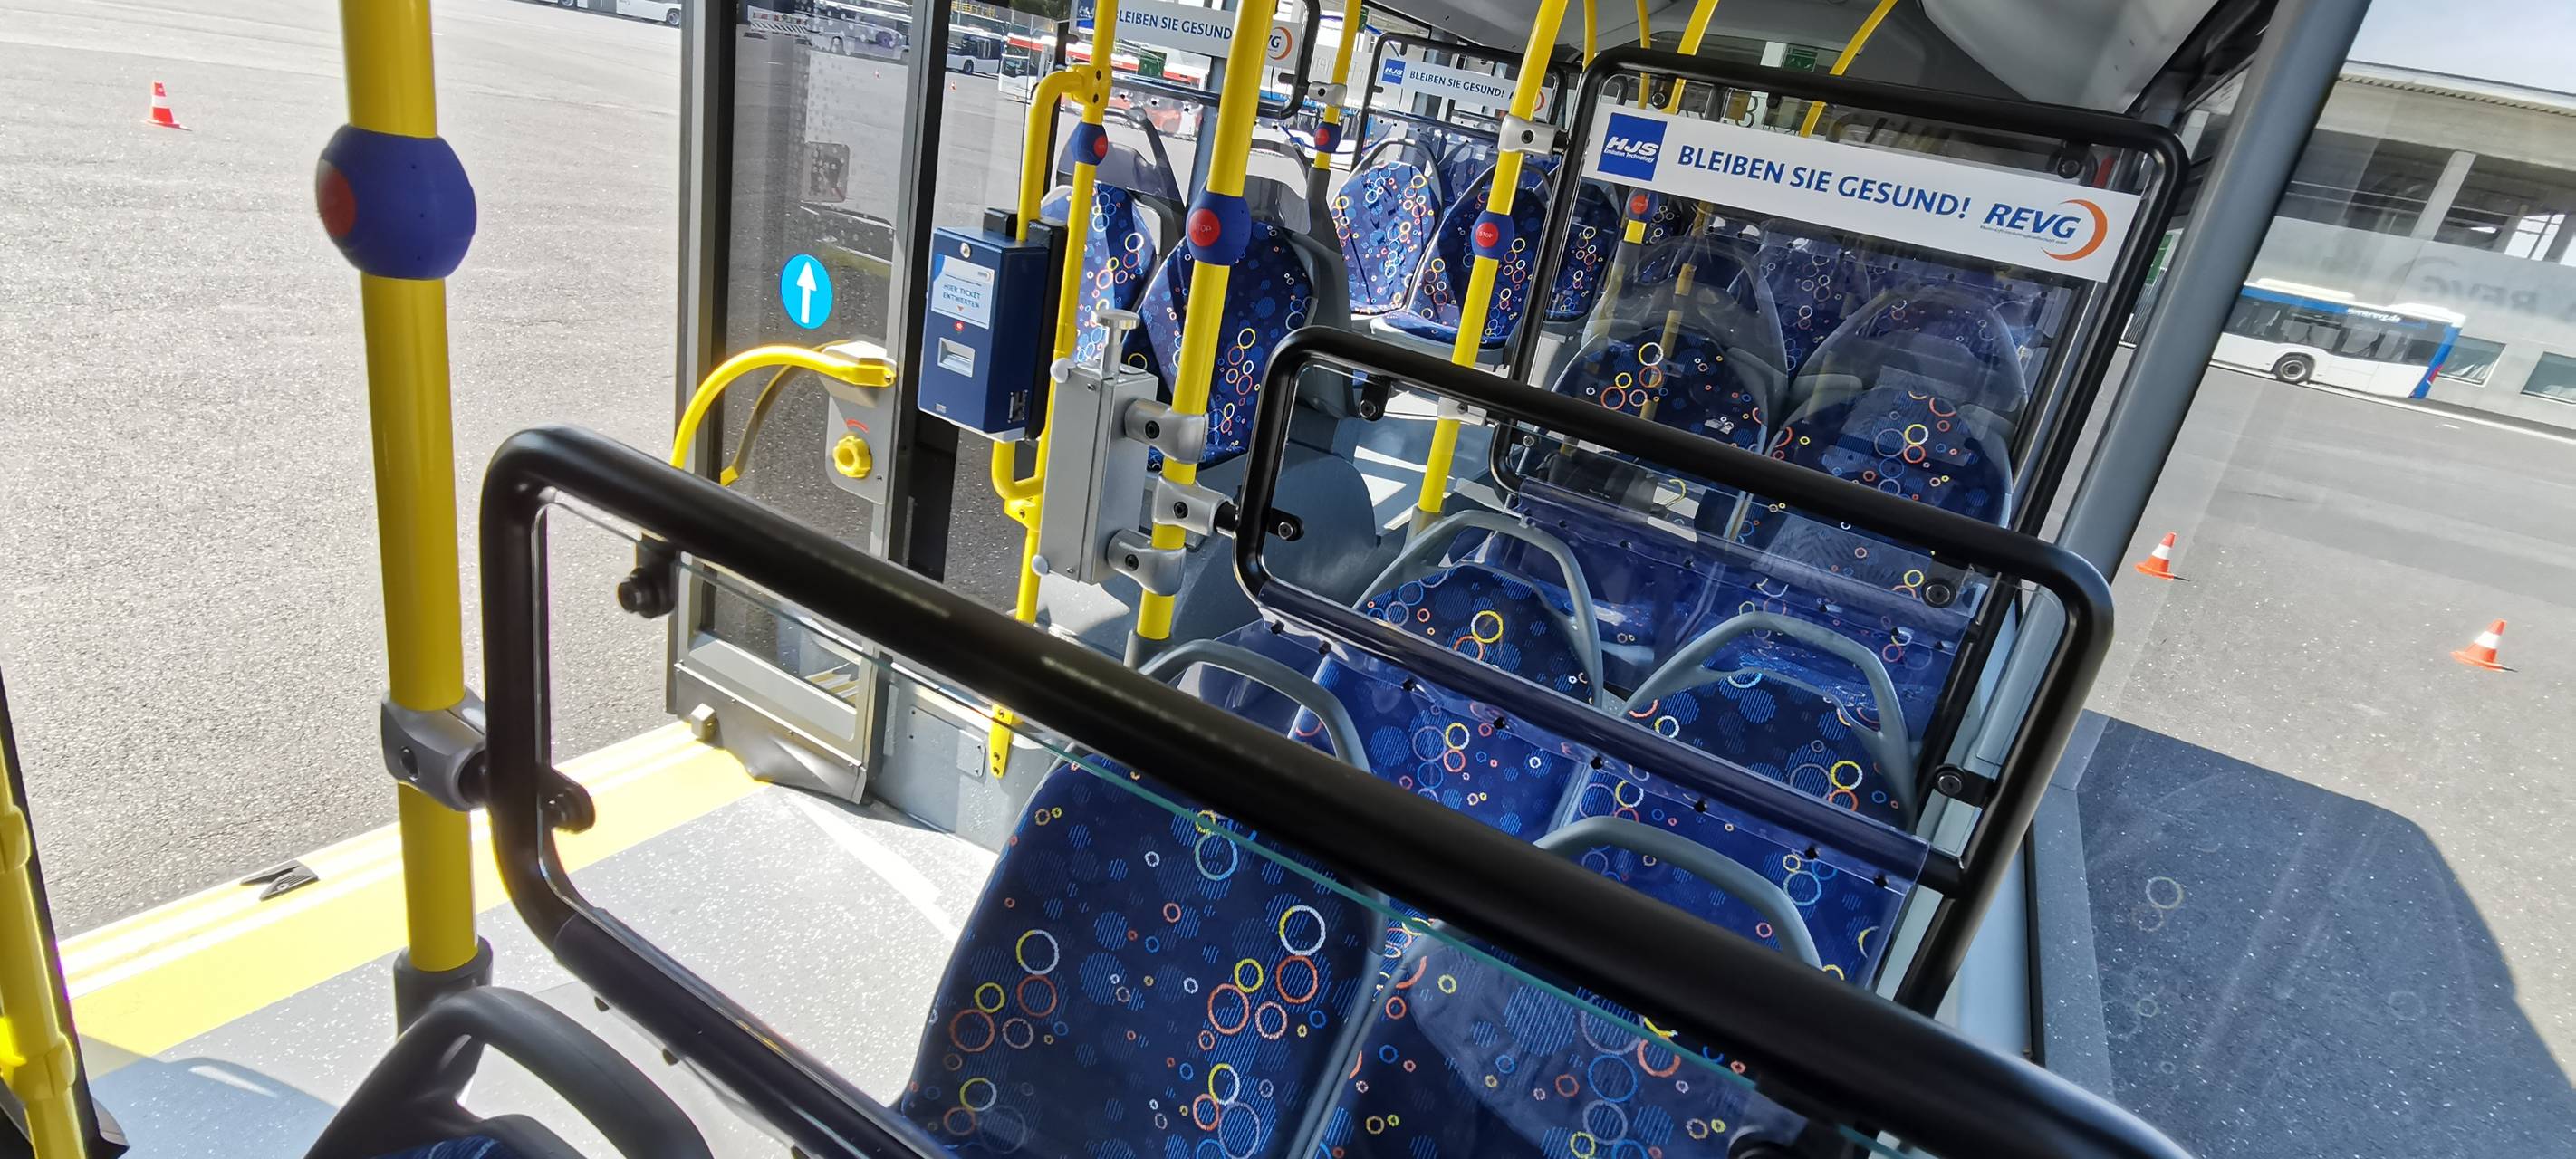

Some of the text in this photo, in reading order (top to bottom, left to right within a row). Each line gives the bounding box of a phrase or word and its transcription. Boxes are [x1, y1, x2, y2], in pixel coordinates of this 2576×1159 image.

[1116, 9, 1158, 30] LEIBEN
[1160, 16, 1178, 31] SIE
[1384, 66, 1403, 76] HJS
[1409, 71, 1446, 85] BLEIBEN
[1447, 79, 1463, 89] SIE
[1463, 81, 1504, 99] GESUND!
[1606, 136, 1659, 156] HJS
[1626, 153, 1655, 164] Technology
[1677, 145, 1785, 184] BLEIBEN
[1790, 166, 1832, 193] SIE
[1837, 175, 1972, 220] GESUND!
[1983, 202, 2081, 239] REVG
[1478, 230, 1494, 239] STOP
[943, 292, 980, 308] ENTWERTEN
[960, 287, 981, 300] TICKET
